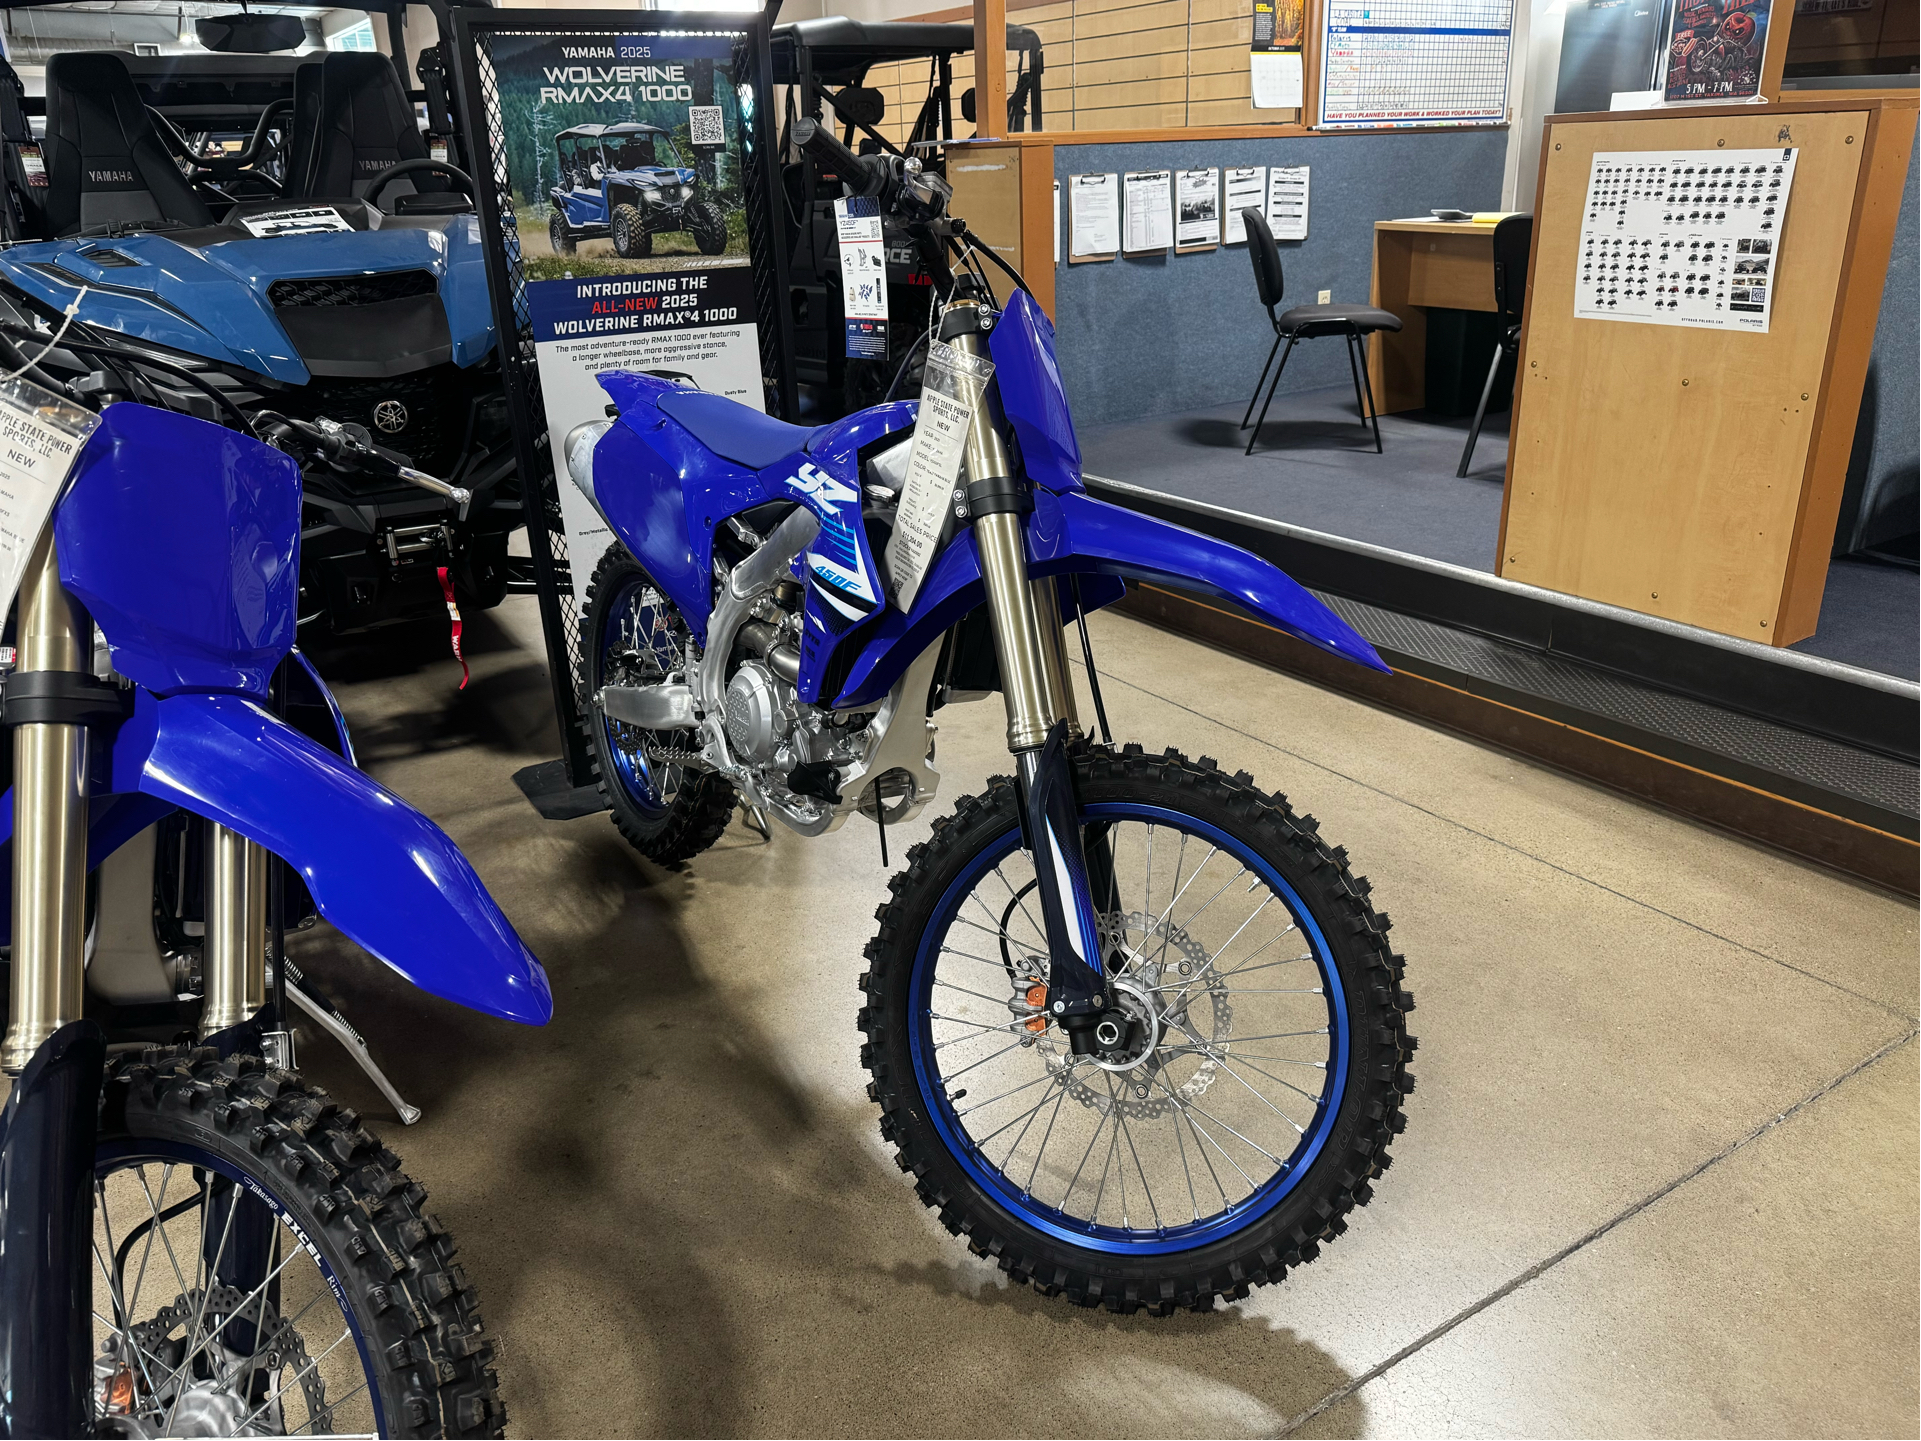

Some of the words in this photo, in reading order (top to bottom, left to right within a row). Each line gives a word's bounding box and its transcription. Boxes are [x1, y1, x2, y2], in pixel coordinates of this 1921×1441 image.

[561, 47, 615, 59] YAMAHA
[620, 46, 651, 58] 2025
[543, 66, 685, 84] WOLVERINE
[540, 86, 631, 104] RMAX4
[639, 85, 692, 102] 1000
[1686, 84, 1691, 93] 5
[1693, 83, 1705, 94] PM
[1720, 81, 1733, 92] PM
[89, 171, 134, 182] YAMAHA
[577, 278, 676, 298] INTRODUCING
[681, 276, 708, 290] THE
[591, 297, 658, 314] ALL-NEW
[662, 294, 698, 309] 2025
[554, 315, 639, 335] WOLVERINE
[703, 307, 737, 322] 1000
[556, 345, 569, 354] The
[571, 343, 589, 352] most
[591, 338, 650, 351] adventure-ready
[651, 335, 672, 345] RMAX
[674, 333, 691, 343] 1000
[693, 333, 708, 341] ever
[709, 330, 741, 342] featuring
[578, 352, 601, 364] longer
[603, 348, 643, 361] wheelbase,
[644, 347, 661, 356] more
[663, 343, 701, 356] aggressive
[702, 341, 728, 351] stance,
[584, 362, 599, 371] and
[599, 359, 622, 372] plenty
[623, 358, 631, 367] of
[632, 357, 651, 366] room
[652, 355, 662, 364] for
[663, 352, 686, 364] family
[686, 352, 700, 361] and
[701, 351, 718, 362] gear.
[940, 399, 953, 412] STATE
[953, 405, 970, 419] POWER
[937, 421, 951, 432] NEW
[20, 421, 48, 442] STATE
[46, 434, 73, 455] POWER
[7, 449, 36, 468] NEW
[897, 514, 910, 527] TOTAL
[909, 521, 922, 535] SALES
[814, 565, 862, 591] 450F
[281, 1210, 322, 1267] EXCEL
